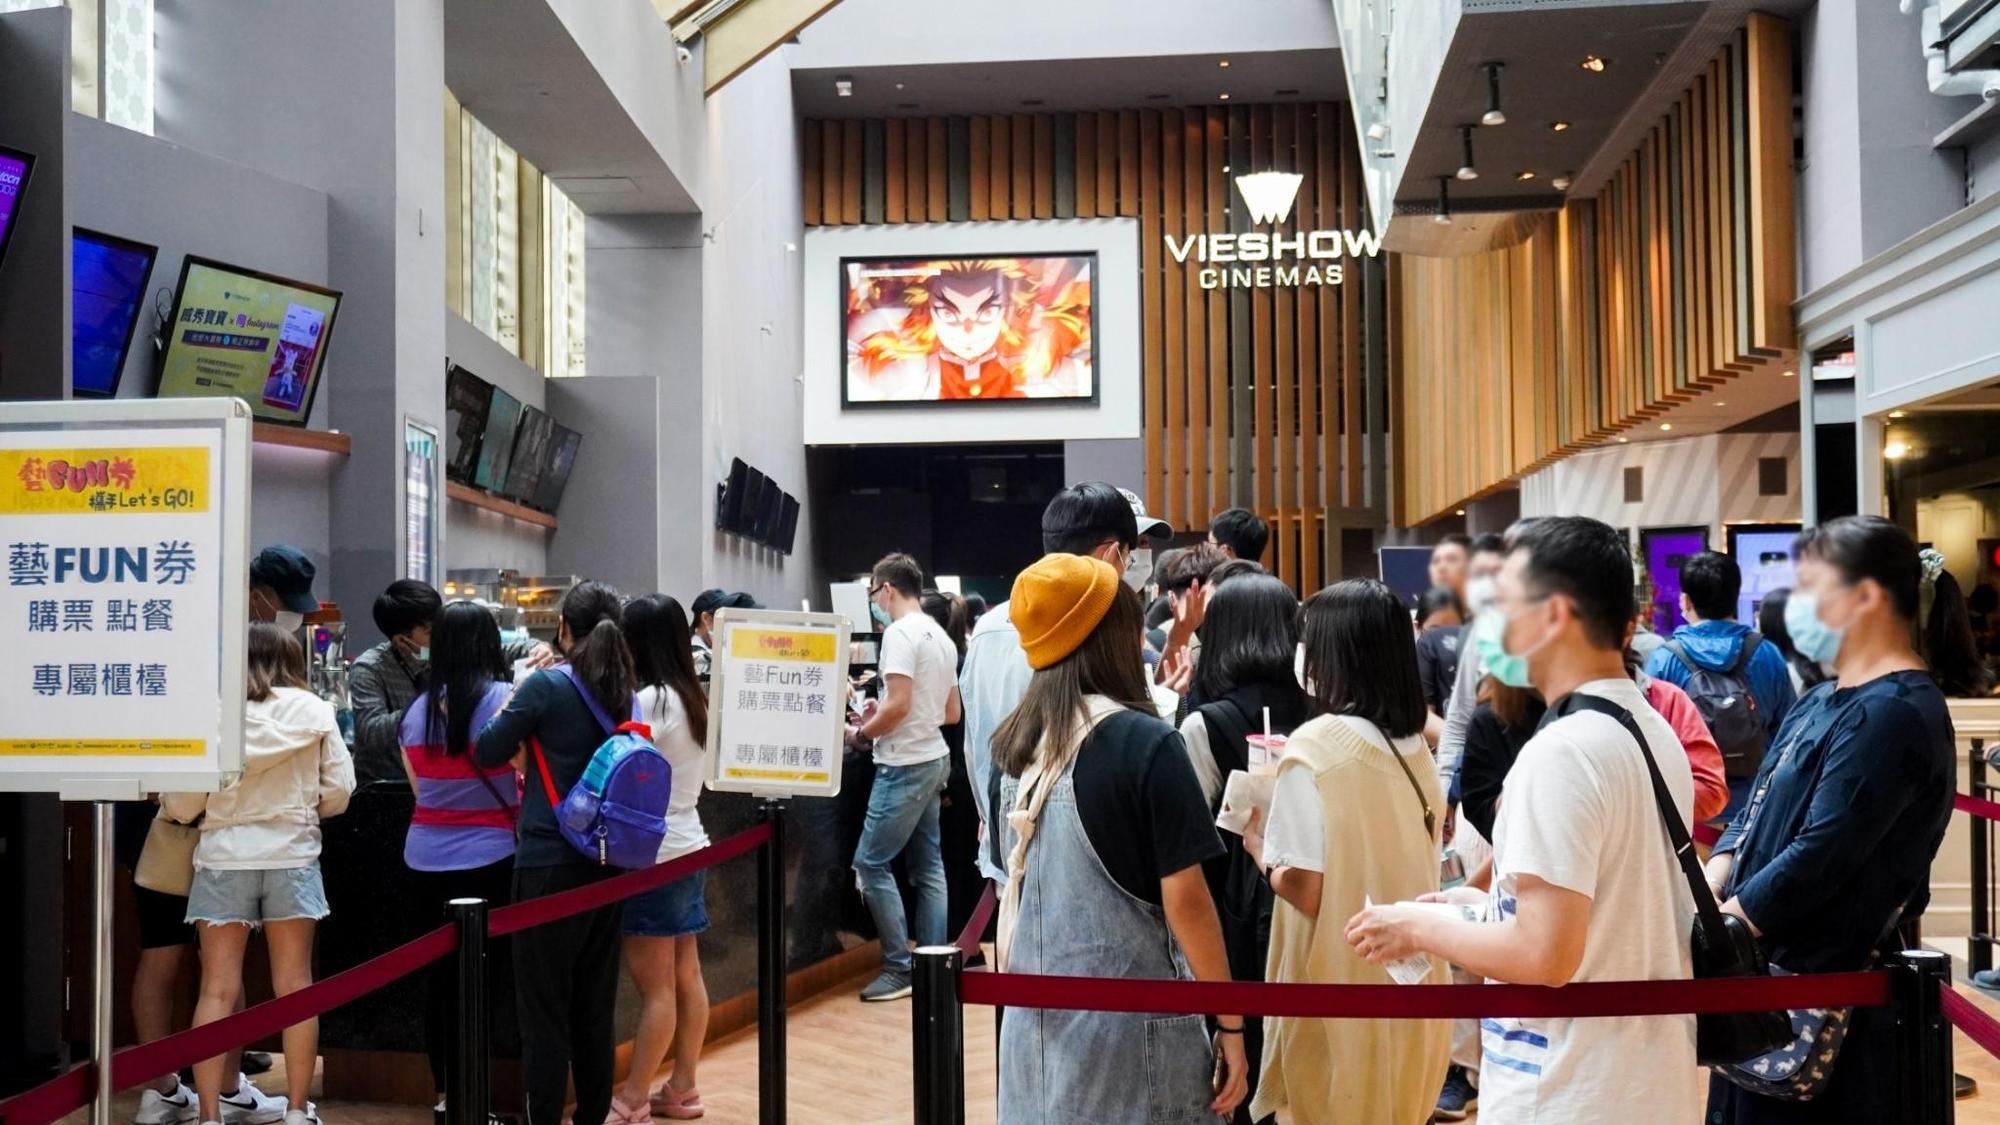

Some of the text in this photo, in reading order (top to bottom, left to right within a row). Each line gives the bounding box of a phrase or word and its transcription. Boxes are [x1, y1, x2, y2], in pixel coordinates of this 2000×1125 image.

[1164, 229, 1382, 263] VIESHOW
[1199, 264, 1343, 289] CINEMAS
[246, 317, 279, 331] Instagram
[164, 488, 194, 509] GO!
[9, 540, 196, 586] 藝FUN券
[28, 599, 173, 632] 購票 點餐
[32, 663, 167, 696] 專屬櫃檯
[737, 690, 827, 715] 購票點餐
[736, 743, 824, 768] 專屬櫃檯
